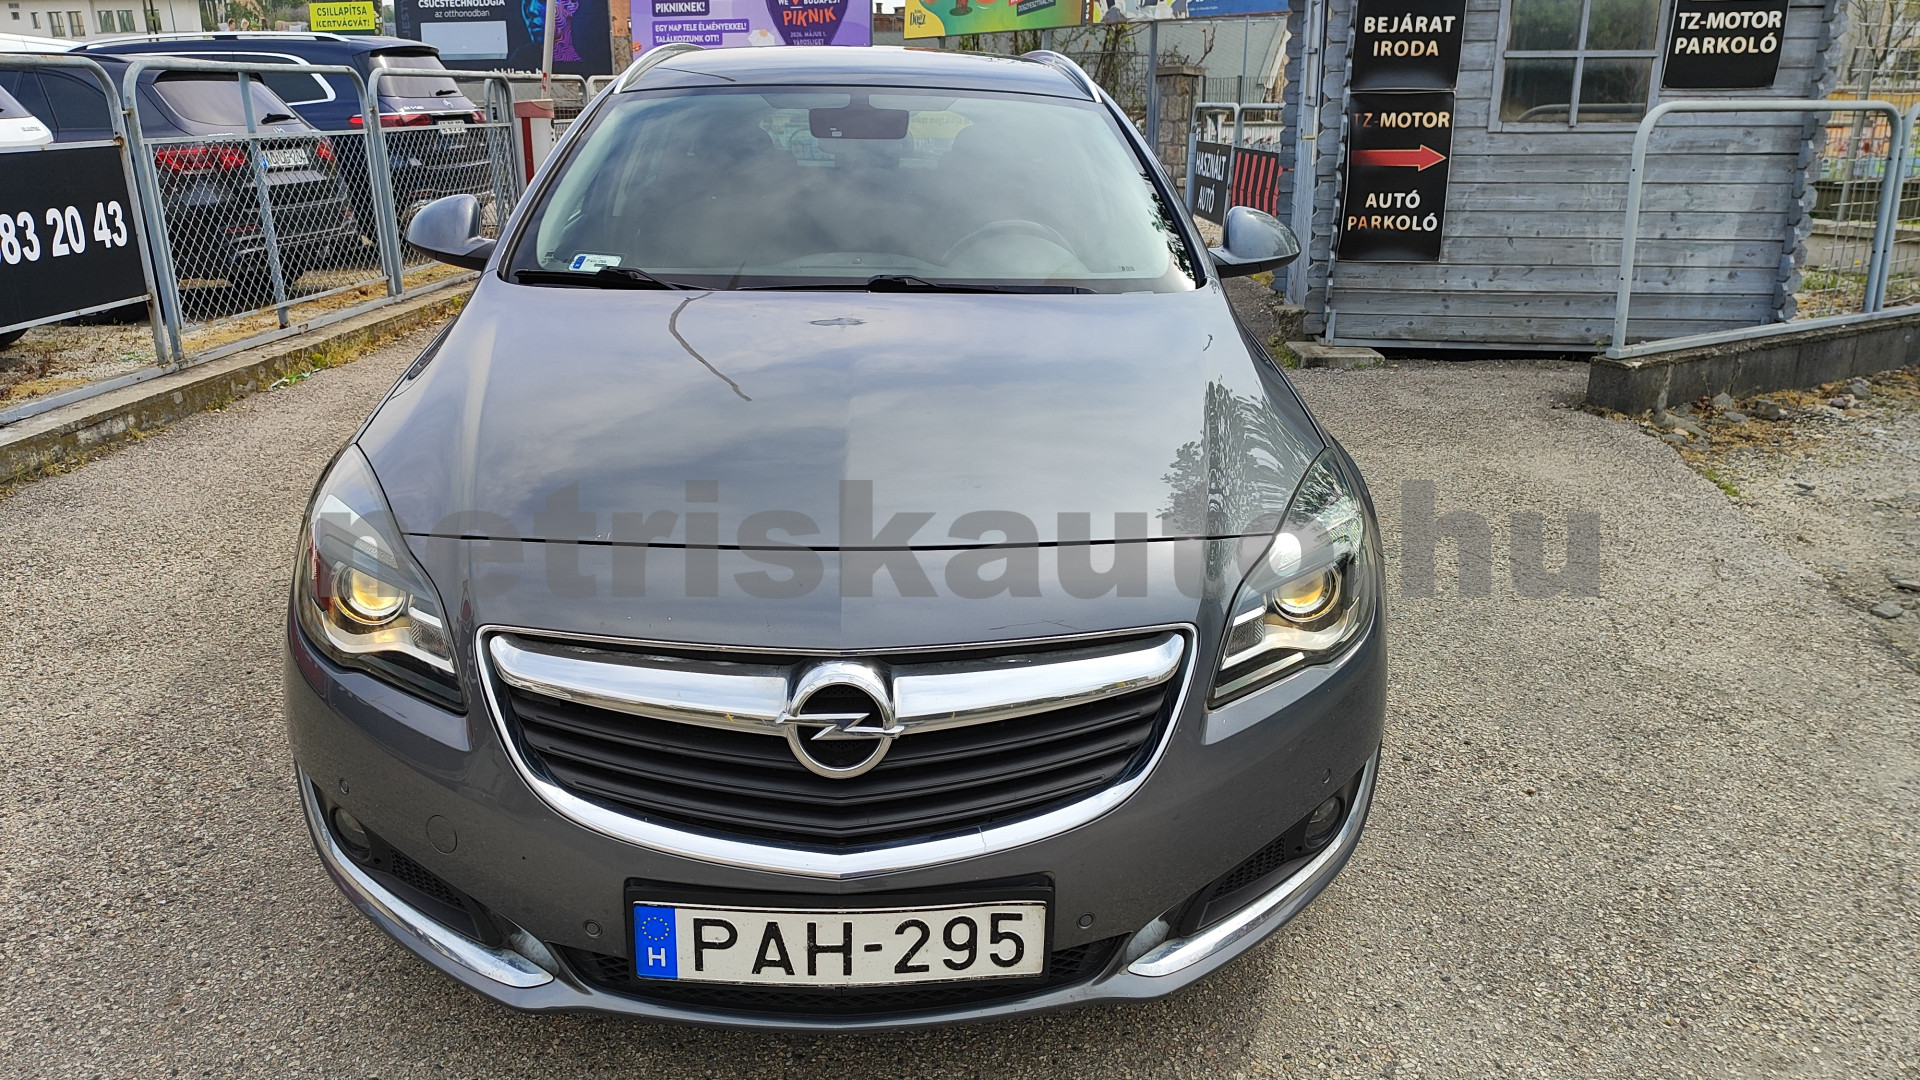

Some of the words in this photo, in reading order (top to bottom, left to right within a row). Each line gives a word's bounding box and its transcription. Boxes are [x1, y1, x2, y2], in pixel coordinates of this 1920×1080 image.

[316, 4, 368, 17] CSILLAPÍTSA
[444, 9, 490, 18] otthonodban
[655, 2, 706, 13] PIKNIKNEK!
[782, 6, 837, 27] PIKNIK
[316, 17, 370, 28] KERTVÁGYÁT!
[655, 24, 668, 32] EGY
[668, 24, 682, 32] NAP
[682, 23, 697, 32] TELE
[698, 21, 747, 31] ÉLMÉNYEKKEL!
[1363, 12, 1456, 34] BEJÁRAT
[1678, 10, 1783, 30] TZ-MOTOR
[655, 33, 704, 43] TALÁLKOZZUNK
[704, 34, 720, 42] OTT!
[1674, 32, 1778, 54] PARKOLÓ
[1373, 40, 1439, 57] IRODA
[1353, 111, 1451, 129] TZ-MOTOR
[1195, 149, 1227, 182] HASZNÁLT
[1197, 183, 1215, 214] AUTÓ
[1365, 189, 1421, 209] AUTÓ
[1347, 212, 1438, 232] PARKOLÓ
[0, 211, 41, 265] 83
[46, 205, 86, 257] 20
[94, 200, 128, 249] 43
[647, 947, 666, 967] H
[692, 912, 1025, 976] PAH-295
